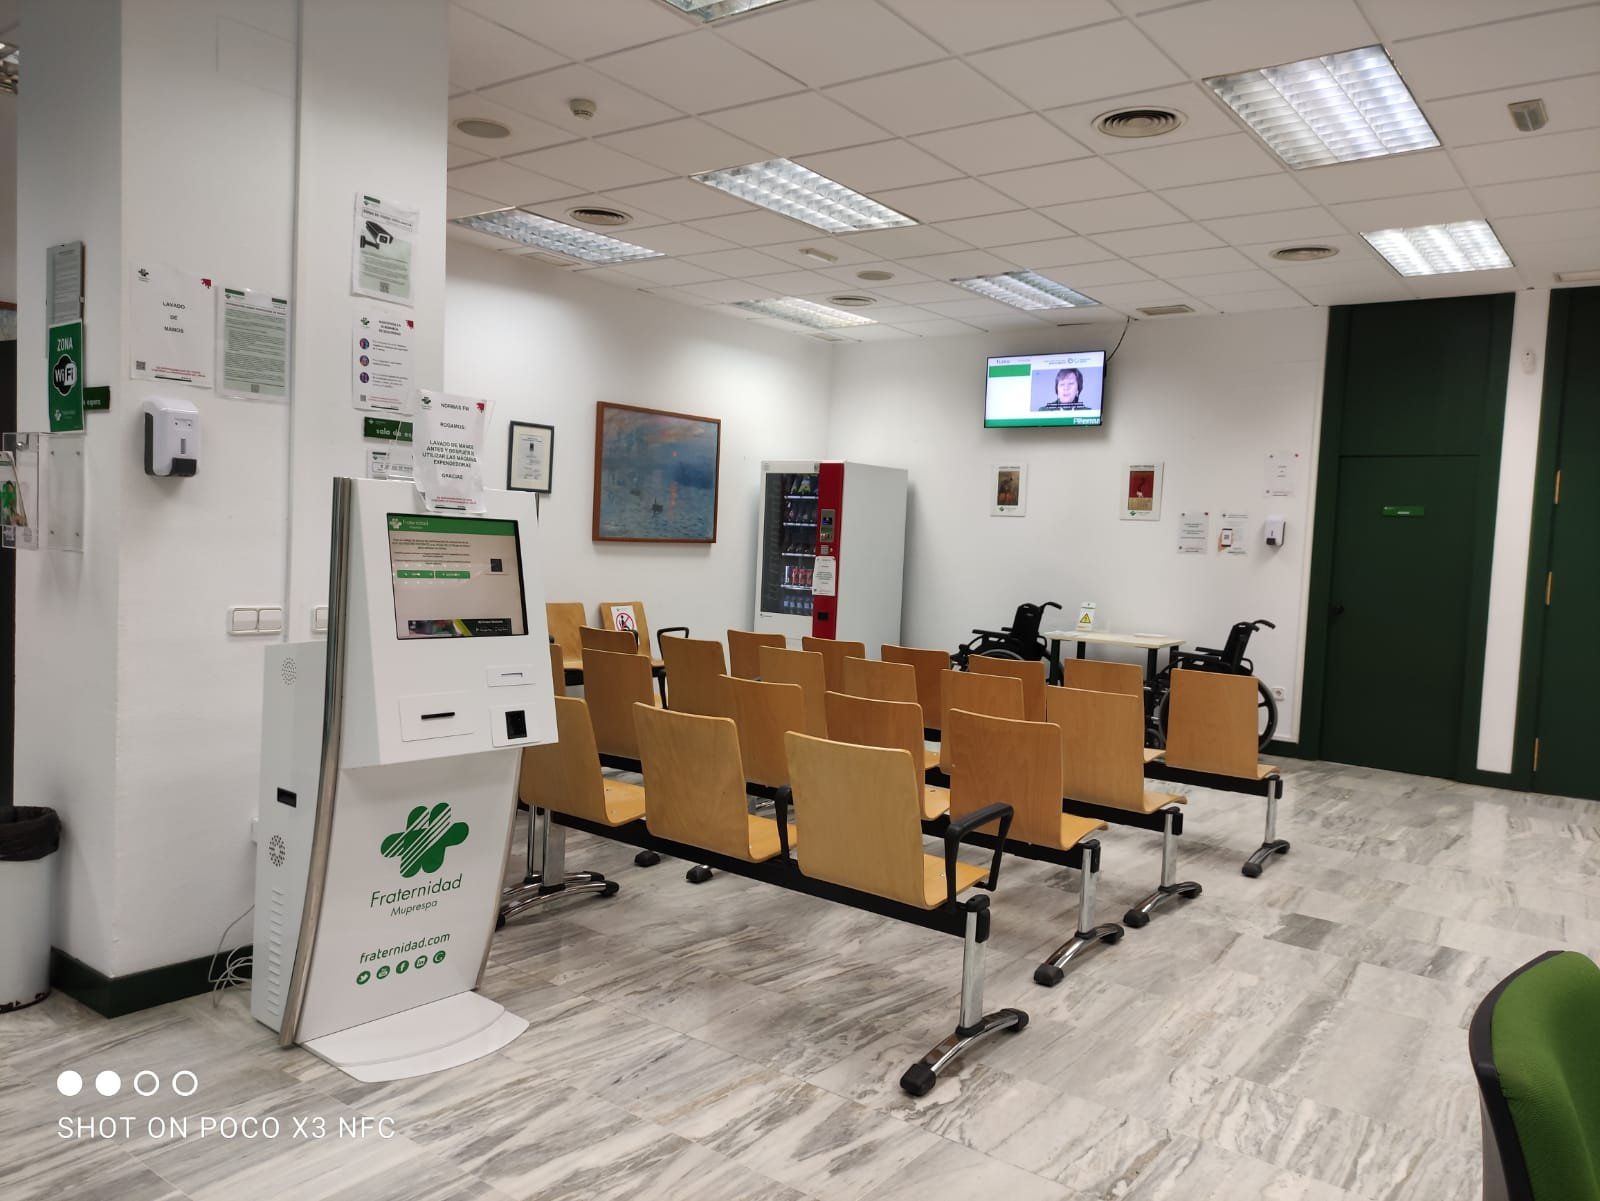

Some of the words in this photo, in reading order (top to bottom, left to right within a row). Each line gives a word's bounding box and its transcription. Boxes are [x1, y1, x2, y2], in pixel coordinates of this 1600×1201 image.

[162, 300, 186, 310] LAVADO
[57, 336, 73, 352] ZONA
[376, 427, 391, 435] sala
[429, 439, 451, 448] LAVADO
[426, 445, 444, 453] ANTES
[422, 451, 446, 459] UTILIZAR
[370, 873, 463, 908] Fraternidad
[390, 899, 438, 917] Muprespa
[359, 932, 451, 964] fraternidad.com
